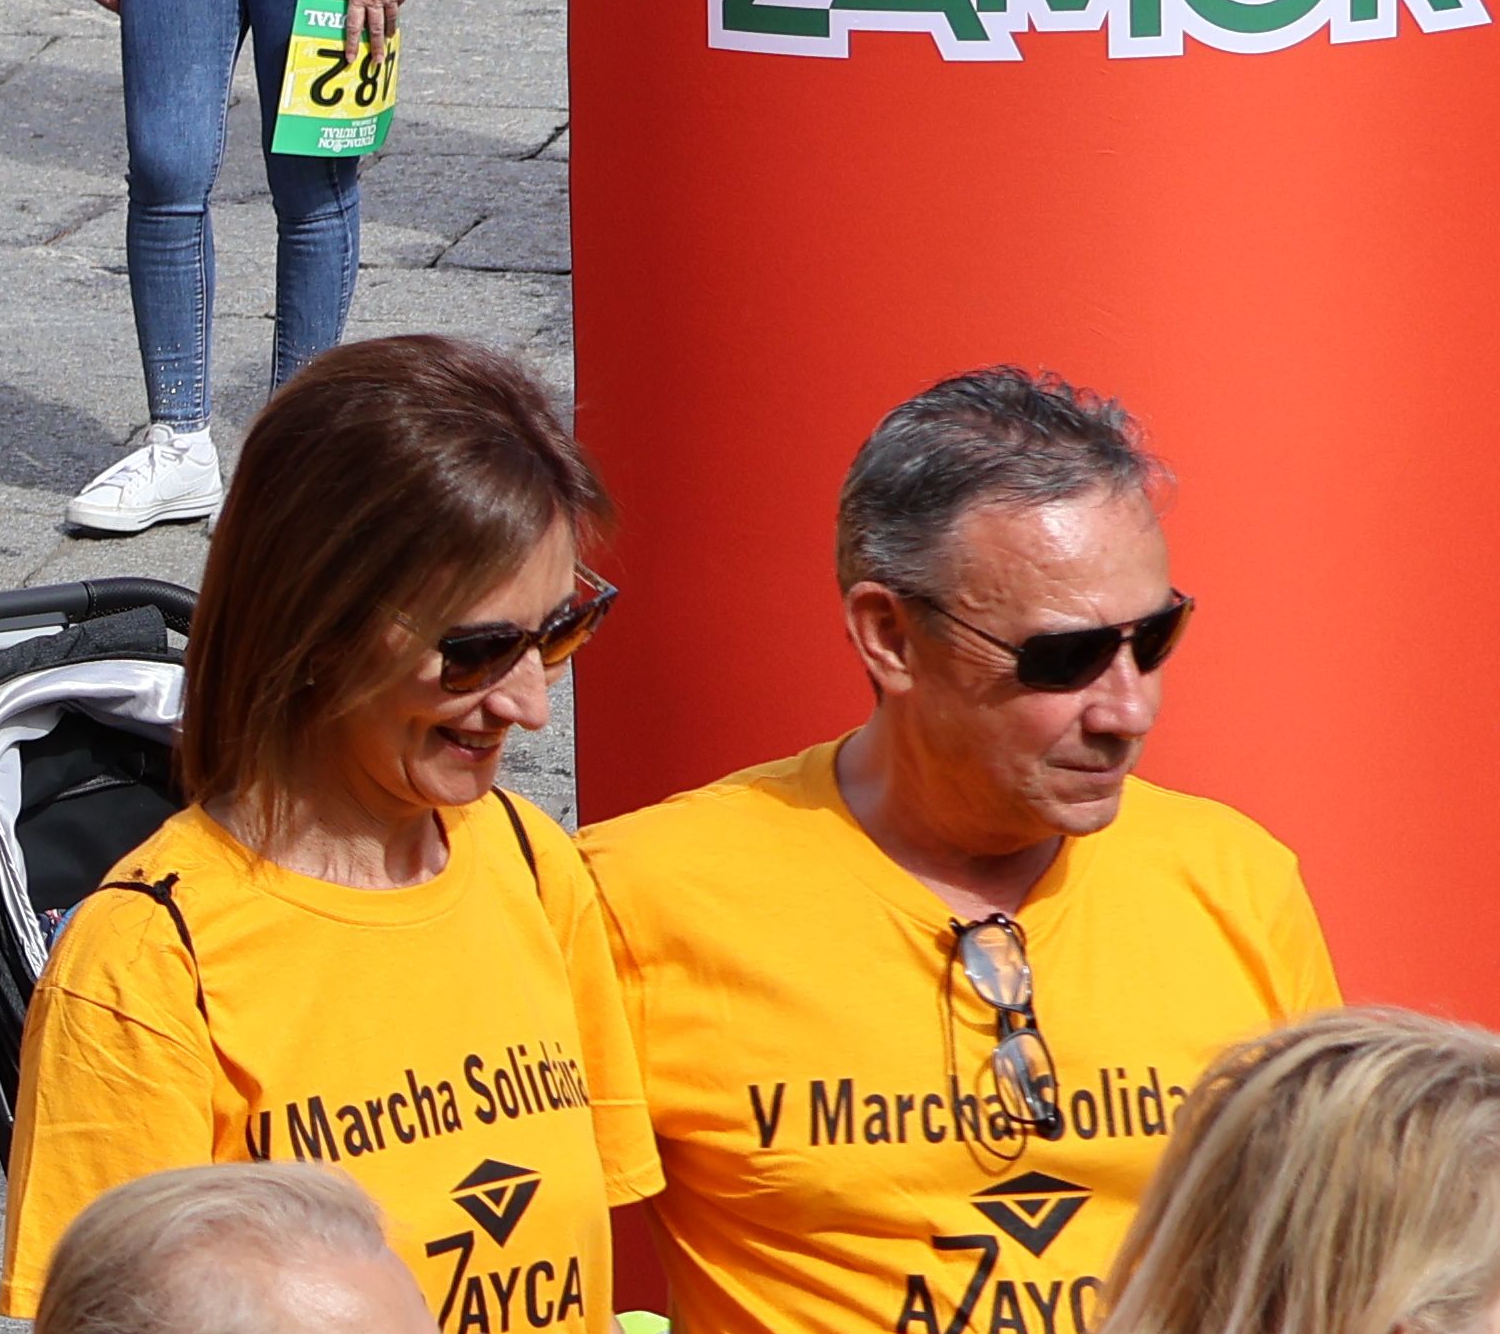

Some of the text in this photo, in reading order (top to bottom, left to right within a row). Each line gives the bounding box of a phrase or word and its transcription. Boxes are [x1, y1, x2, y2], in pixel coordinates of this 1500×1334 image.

[286, 1069, 460, 1163] Marcha
[465, 1040, 590, 1125] Solidaria
[748, 1072, 1015, 1150] V Marcha
